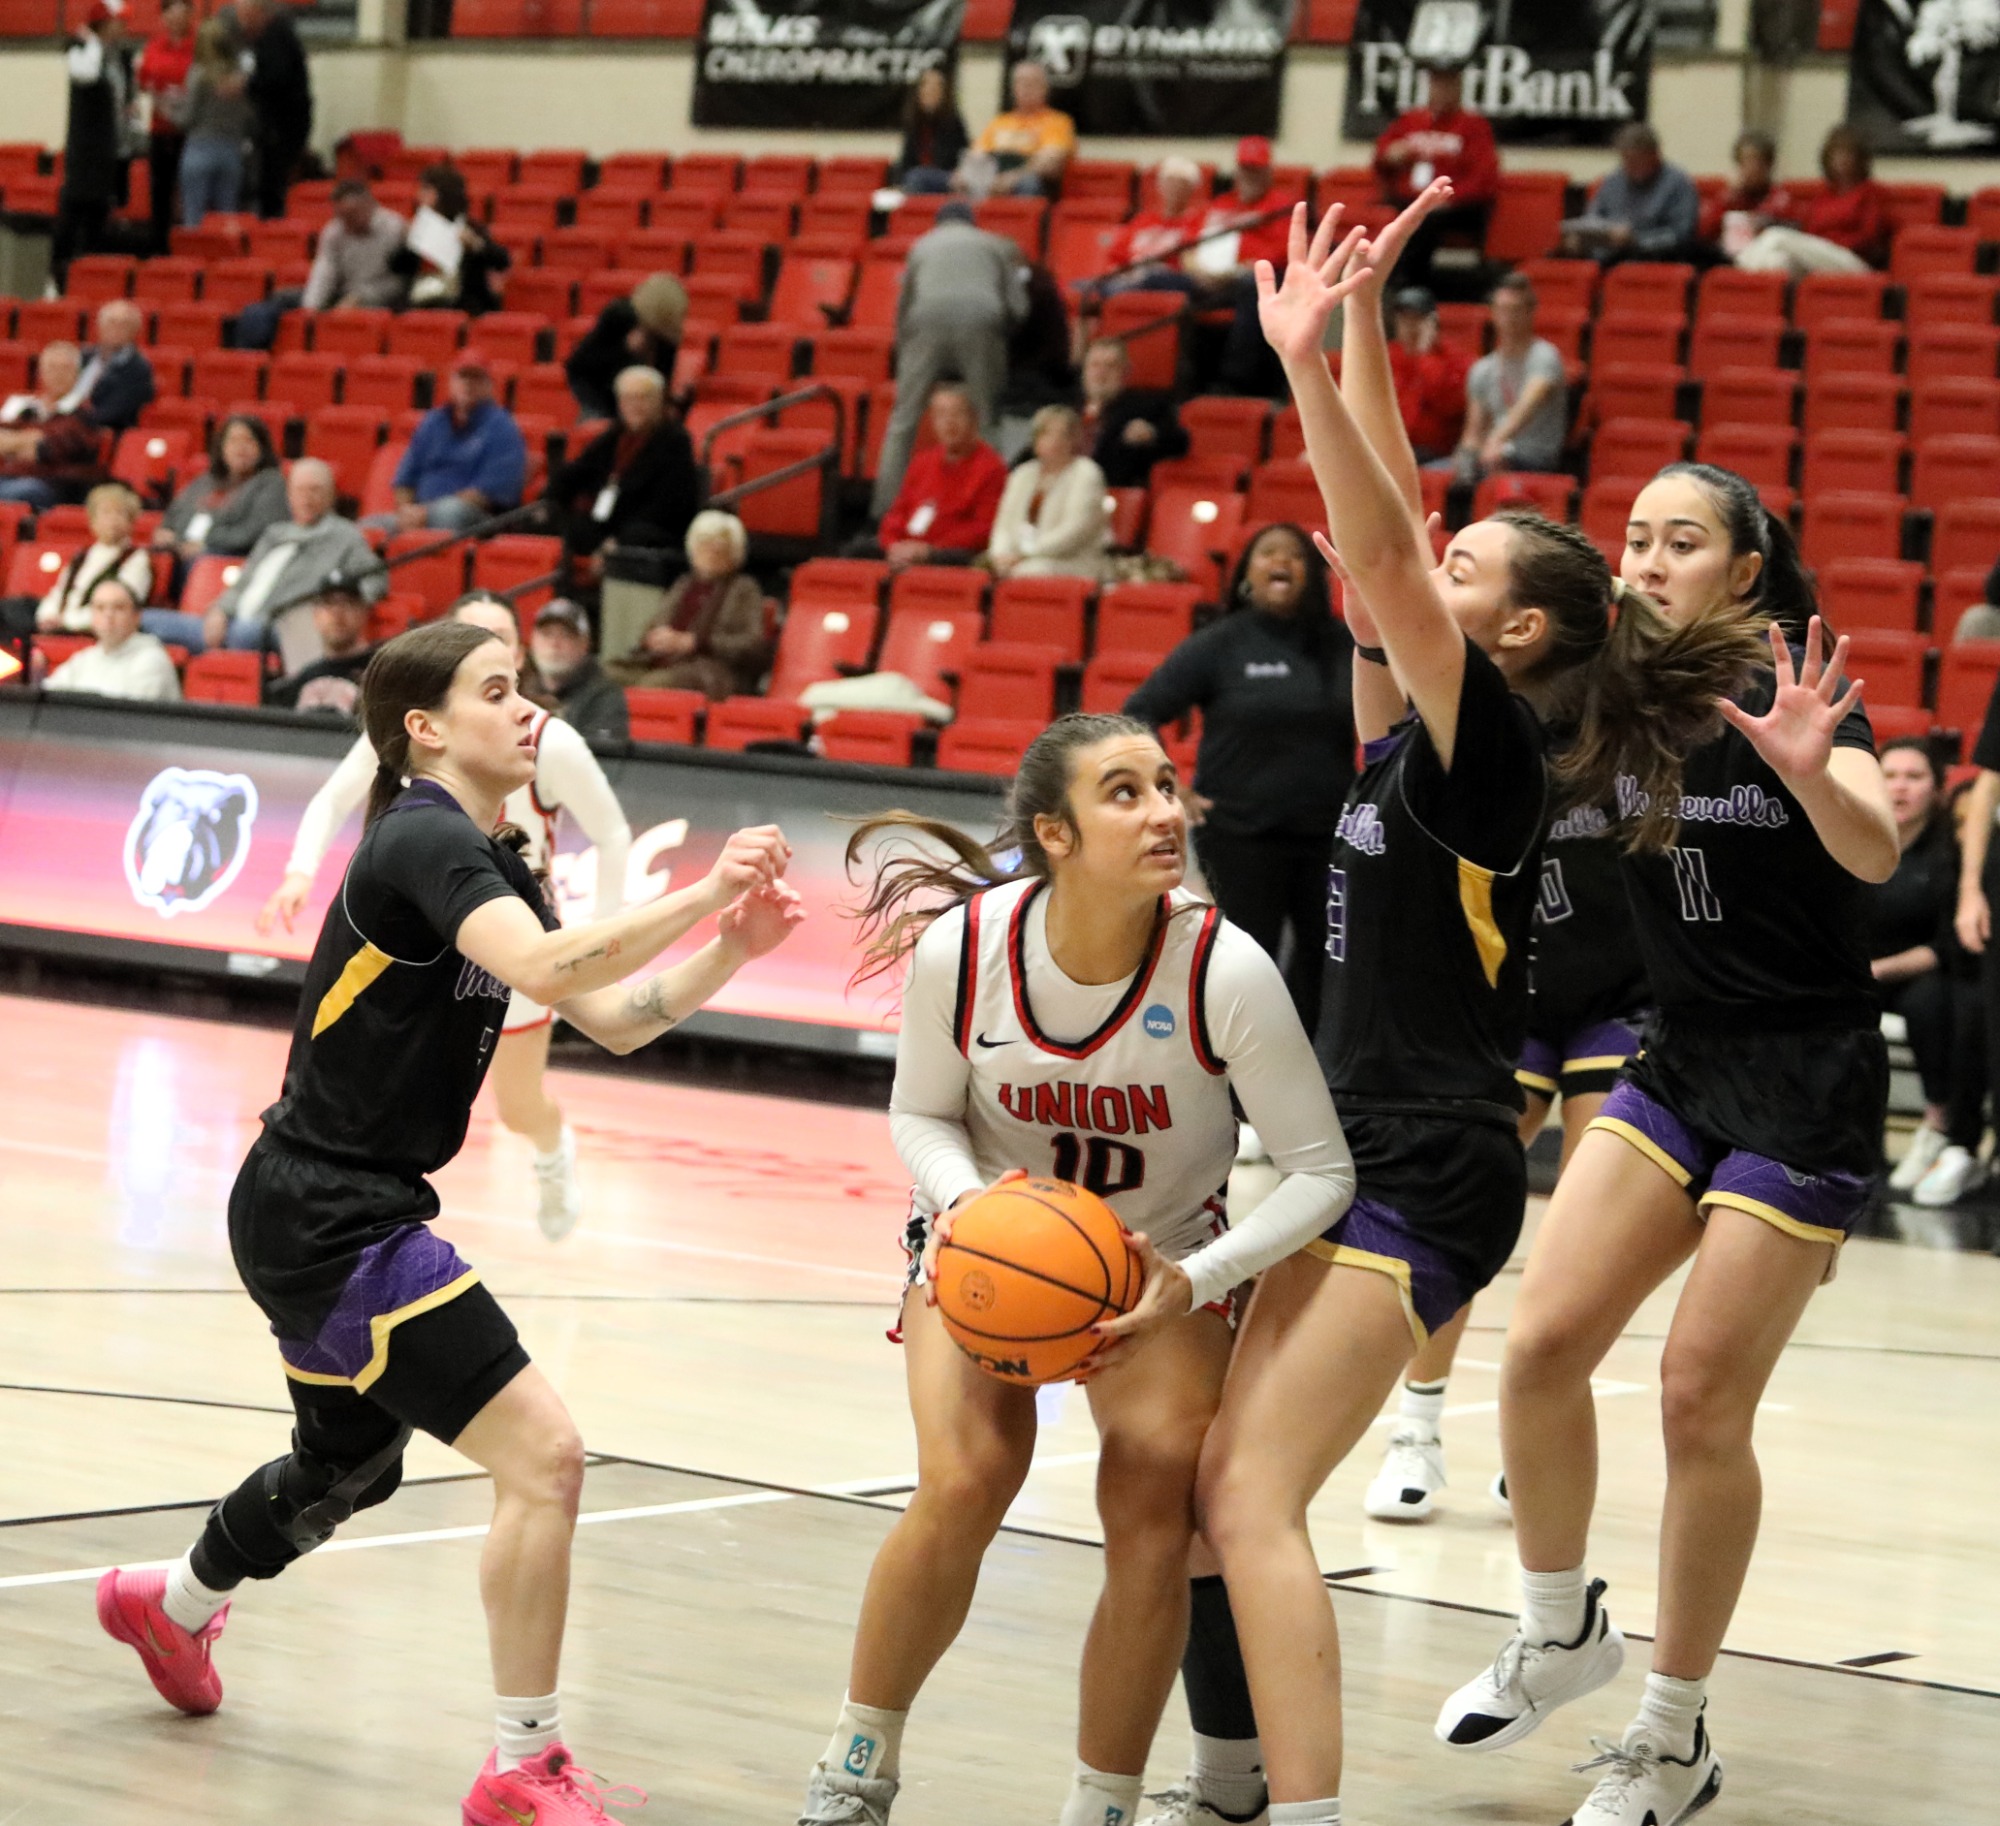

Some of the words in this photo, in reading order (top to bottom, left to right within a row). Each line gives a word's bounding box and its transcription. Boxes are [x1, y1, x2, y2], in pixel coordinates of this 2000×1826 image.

[1359, 42, 1635, 119] FirtBank
[1615, 770, 1788, 828] Moevallo
[1662, 845, 1723, 922] 11
[1146, 1019, 1173, 1033] NCAA
[998, 1080, 1173, 1136] UNION
[1050, 1131, 1146, 1199] 10
